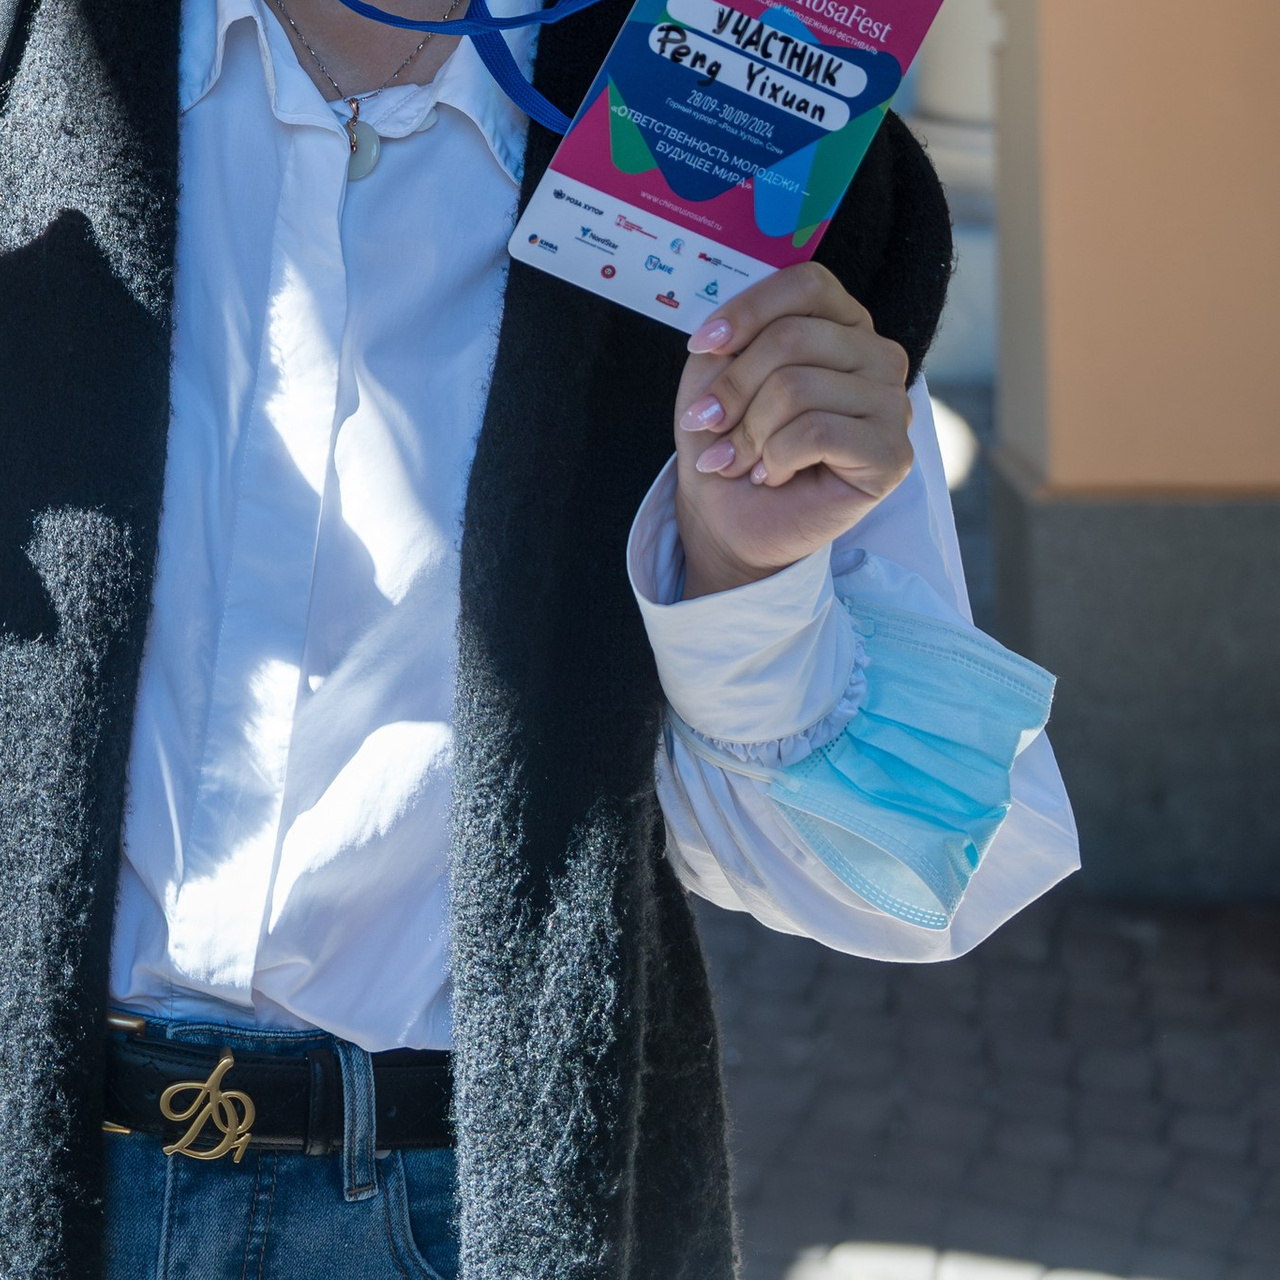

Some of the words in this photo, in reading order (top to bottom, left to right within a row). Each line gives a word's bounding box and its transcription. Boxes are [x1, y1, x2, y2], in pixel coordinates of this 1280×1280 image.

[712, 6, 843, 87] УЧАСТНИК
[781, 5, 837, 36] МОЛОДЕЖНЫЙ
[834, 29, 879, 56] ФЕСТИВАЛЬ
[658, 24, 723, 86] Peng
[747, 61, 825, 122] Yixuan
[664, 96, 693, 114] Горный
[690, 109, 717, 125] курорт
[764, 141, 784, 155] Сочи
[685, 88, 776, 139] 28/09-30/09/2024
[609, 102, 732, 164] «ОТВЕТСТВЕННОСТЬ
[729, 154, 800, 193] МОЛОДЕЖИ
[654, 138, 713, 173] БУДУЩЕЕ
[710, 164, 753, 191] МИРА»
[564, 194, 583, 207] РОЗА
[582, 202, 604, 216] ХУТОР
[639, 189, 723, 232] www.chinarusrosafest.ru
[588, 231, 619, 250] NordStar
